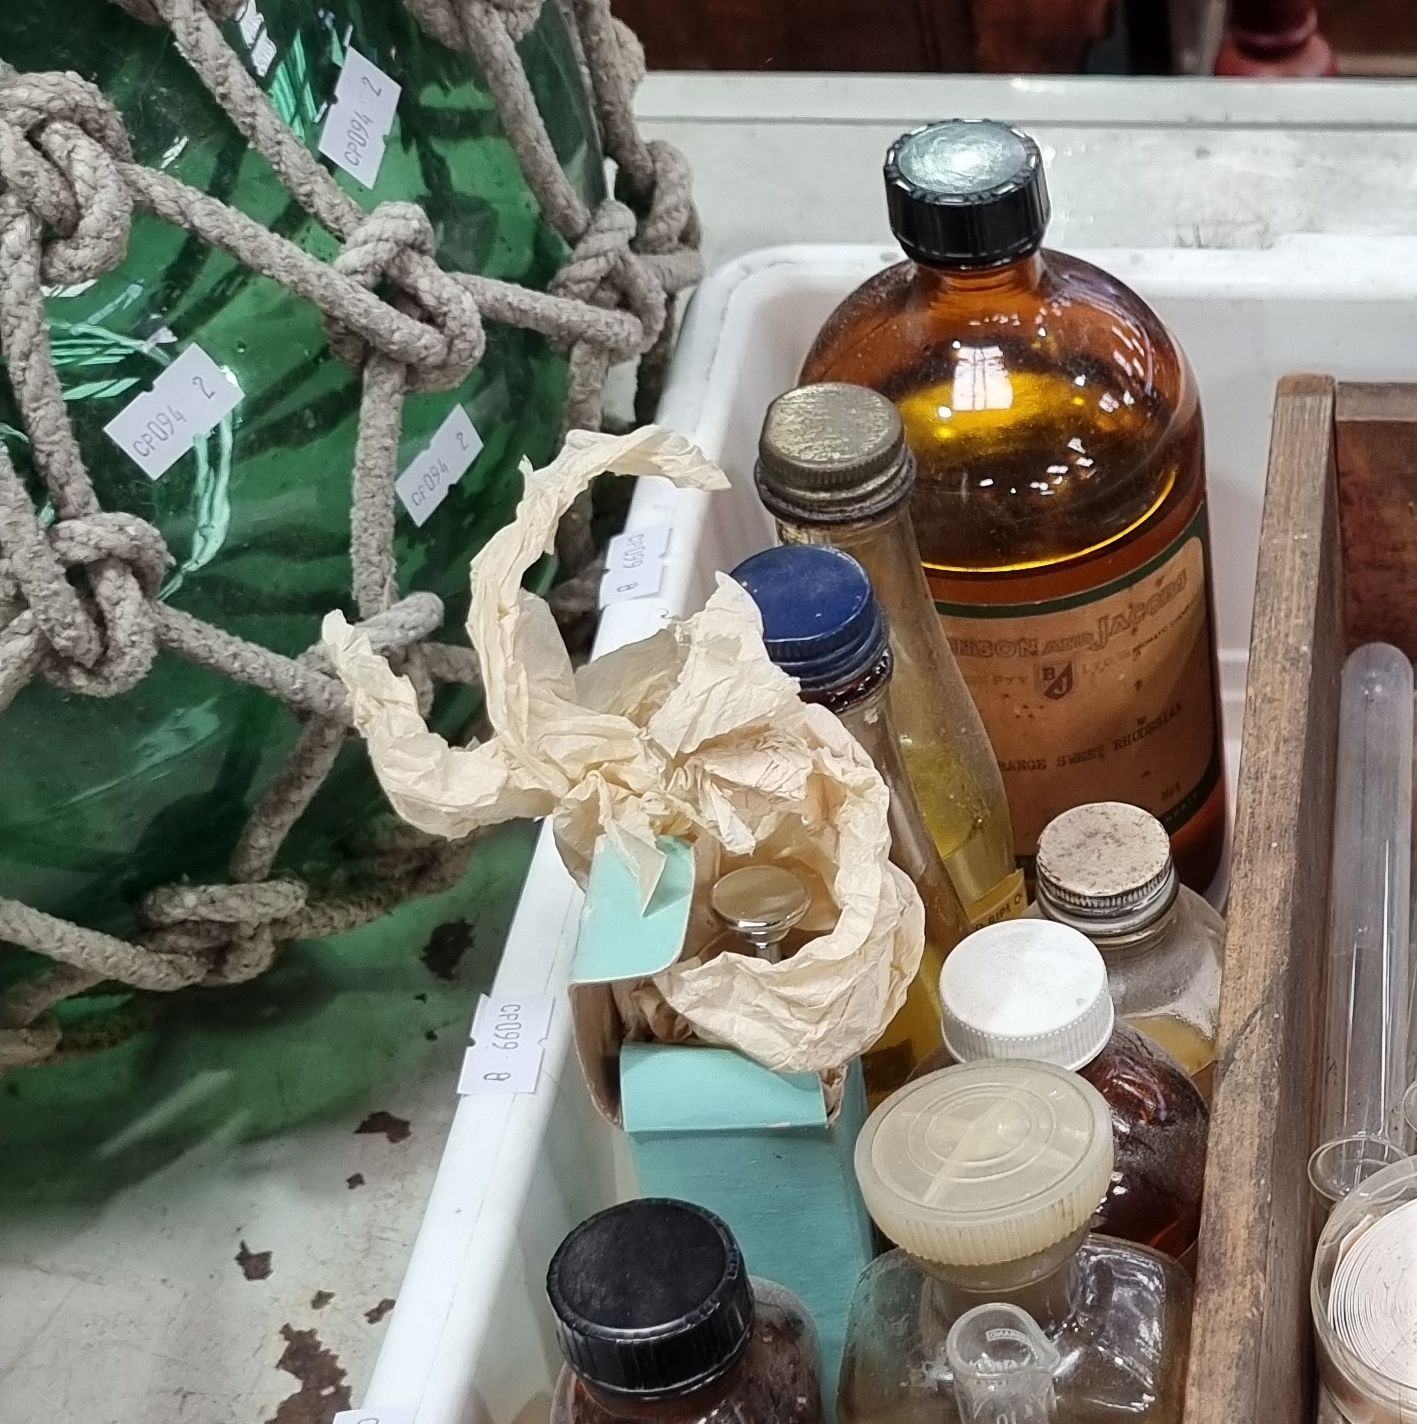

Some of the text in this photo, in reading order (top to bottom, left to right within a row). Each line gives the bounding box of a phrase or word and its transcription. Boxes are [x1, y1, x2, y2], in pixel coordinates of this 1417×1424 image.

[361, 76, 383, 97] 2
[192, 376, 216, 399] 2
[456, 432, 469, 451] 2
[492, 1004, 522, 1050] CP099
